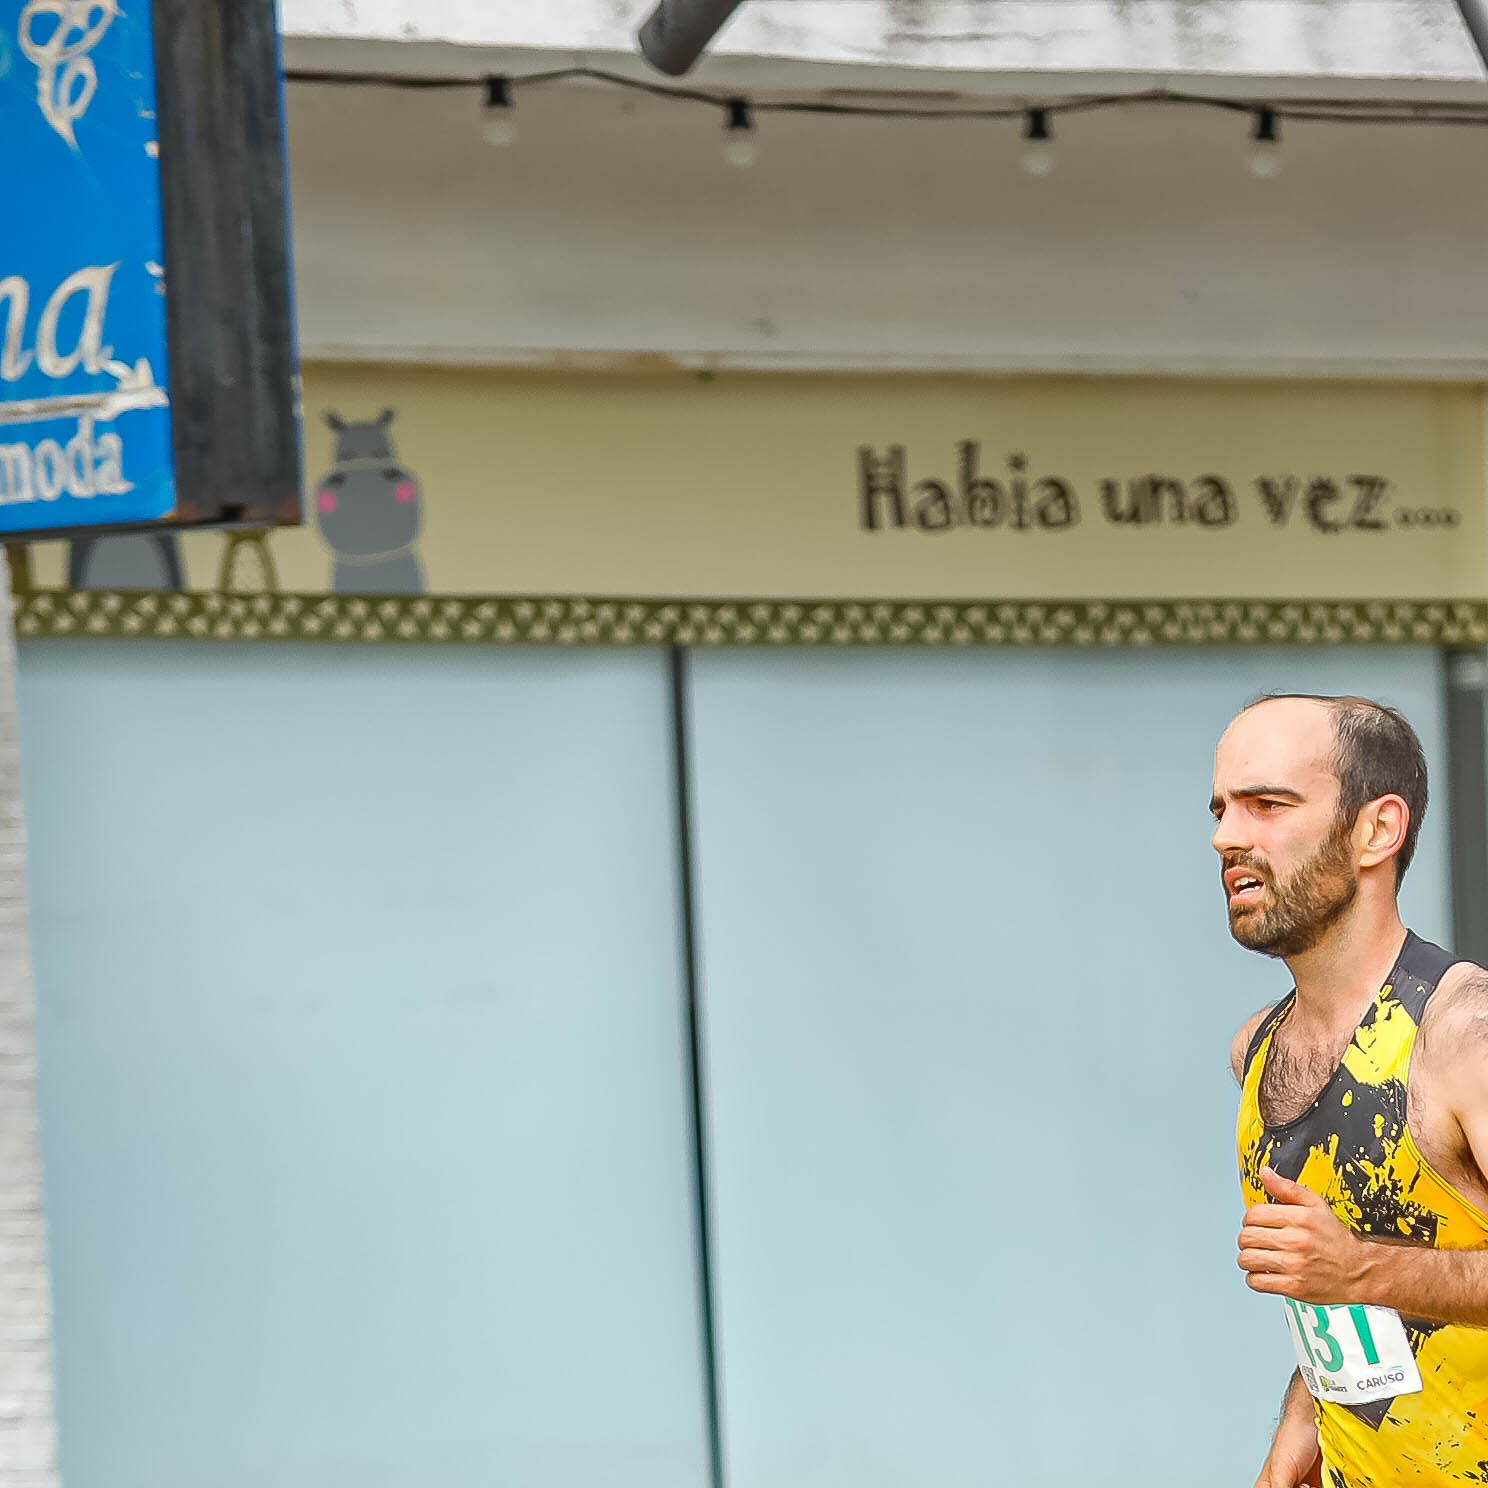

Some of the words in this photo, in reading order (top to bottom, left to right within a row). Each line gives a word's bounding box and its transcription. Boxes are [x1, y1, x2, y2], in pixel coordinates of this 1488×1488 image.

[857, 438, 1078, 534] Habia
[1098, 472, 1239, 531] una
[1356, 1372, 1404, 1390] CARUSO
